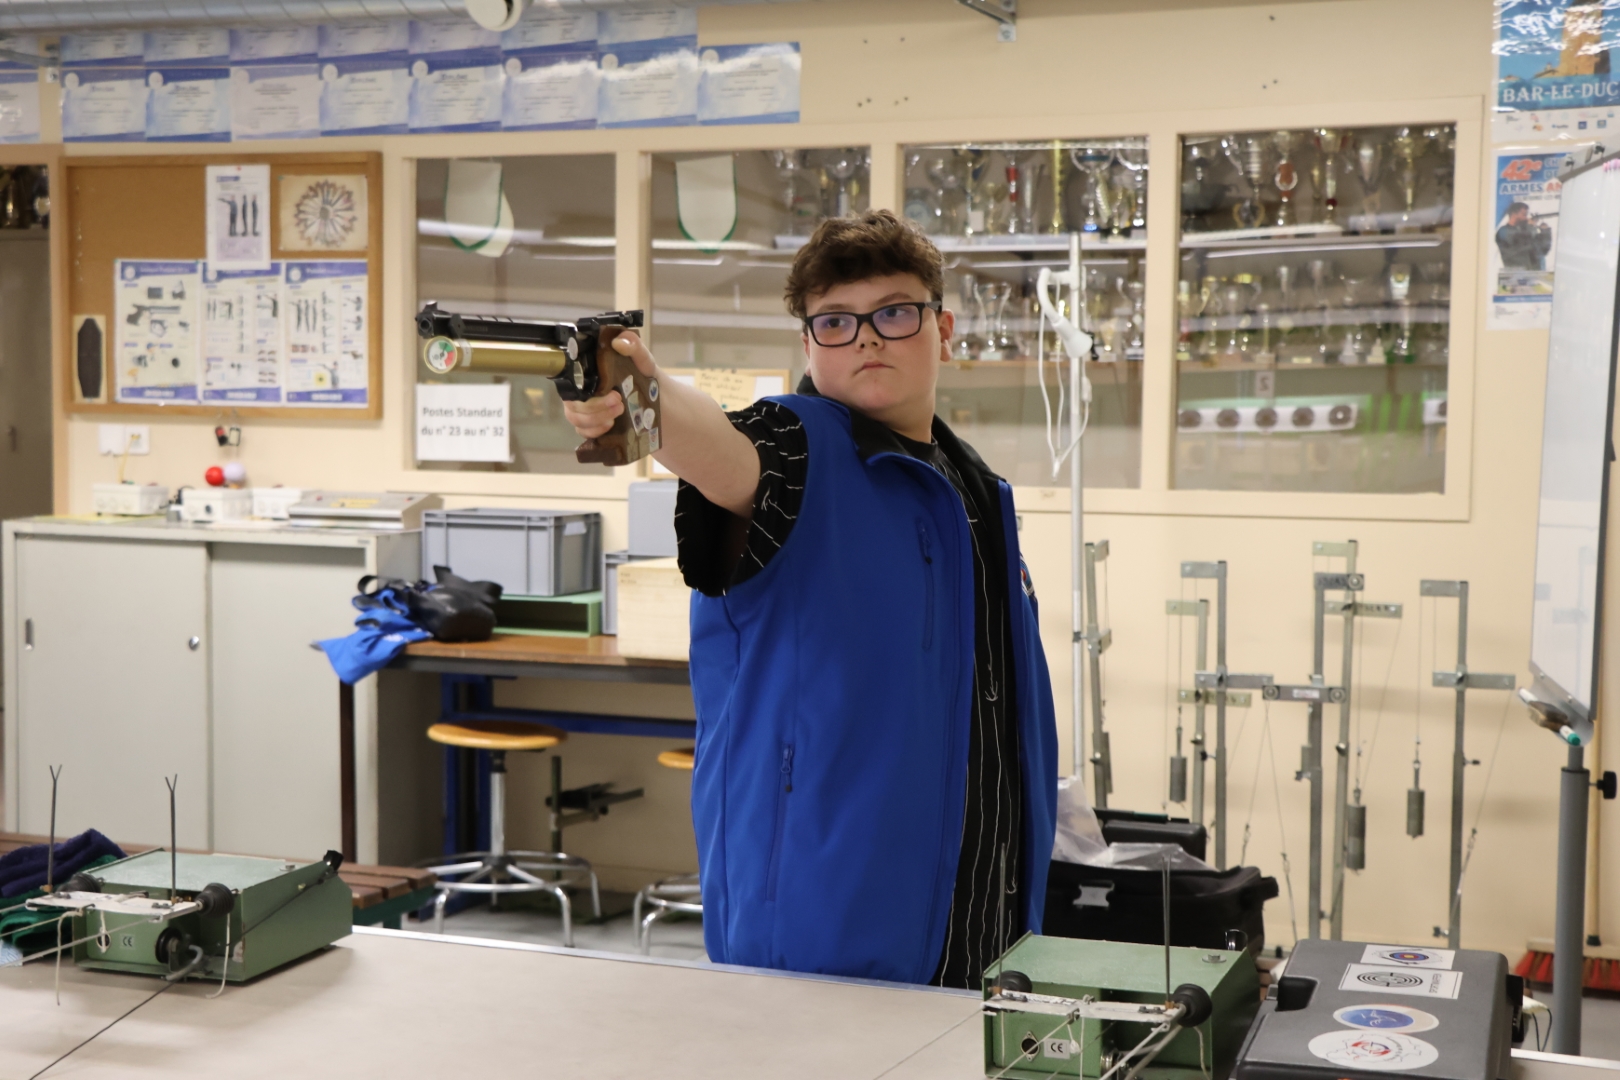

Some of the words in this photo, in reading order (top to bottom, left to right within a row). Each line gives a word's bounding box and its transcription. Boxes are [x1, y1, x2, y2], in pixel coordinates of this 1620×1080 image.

[1502, 81, 1619, 103] BAR-LE-DUC
[1500, 182, 1543, 195] ARMES
[422, 406, 454, 417] Postes
[457, 406, 503, 417] Standard
[421, 425, 434, 436] du
[449, 426, 461, 437] 23
[464, 428, 476, 436] au
[493, 426, 505, 437] 32
[1050, 1042, 1064, 1053] CE
